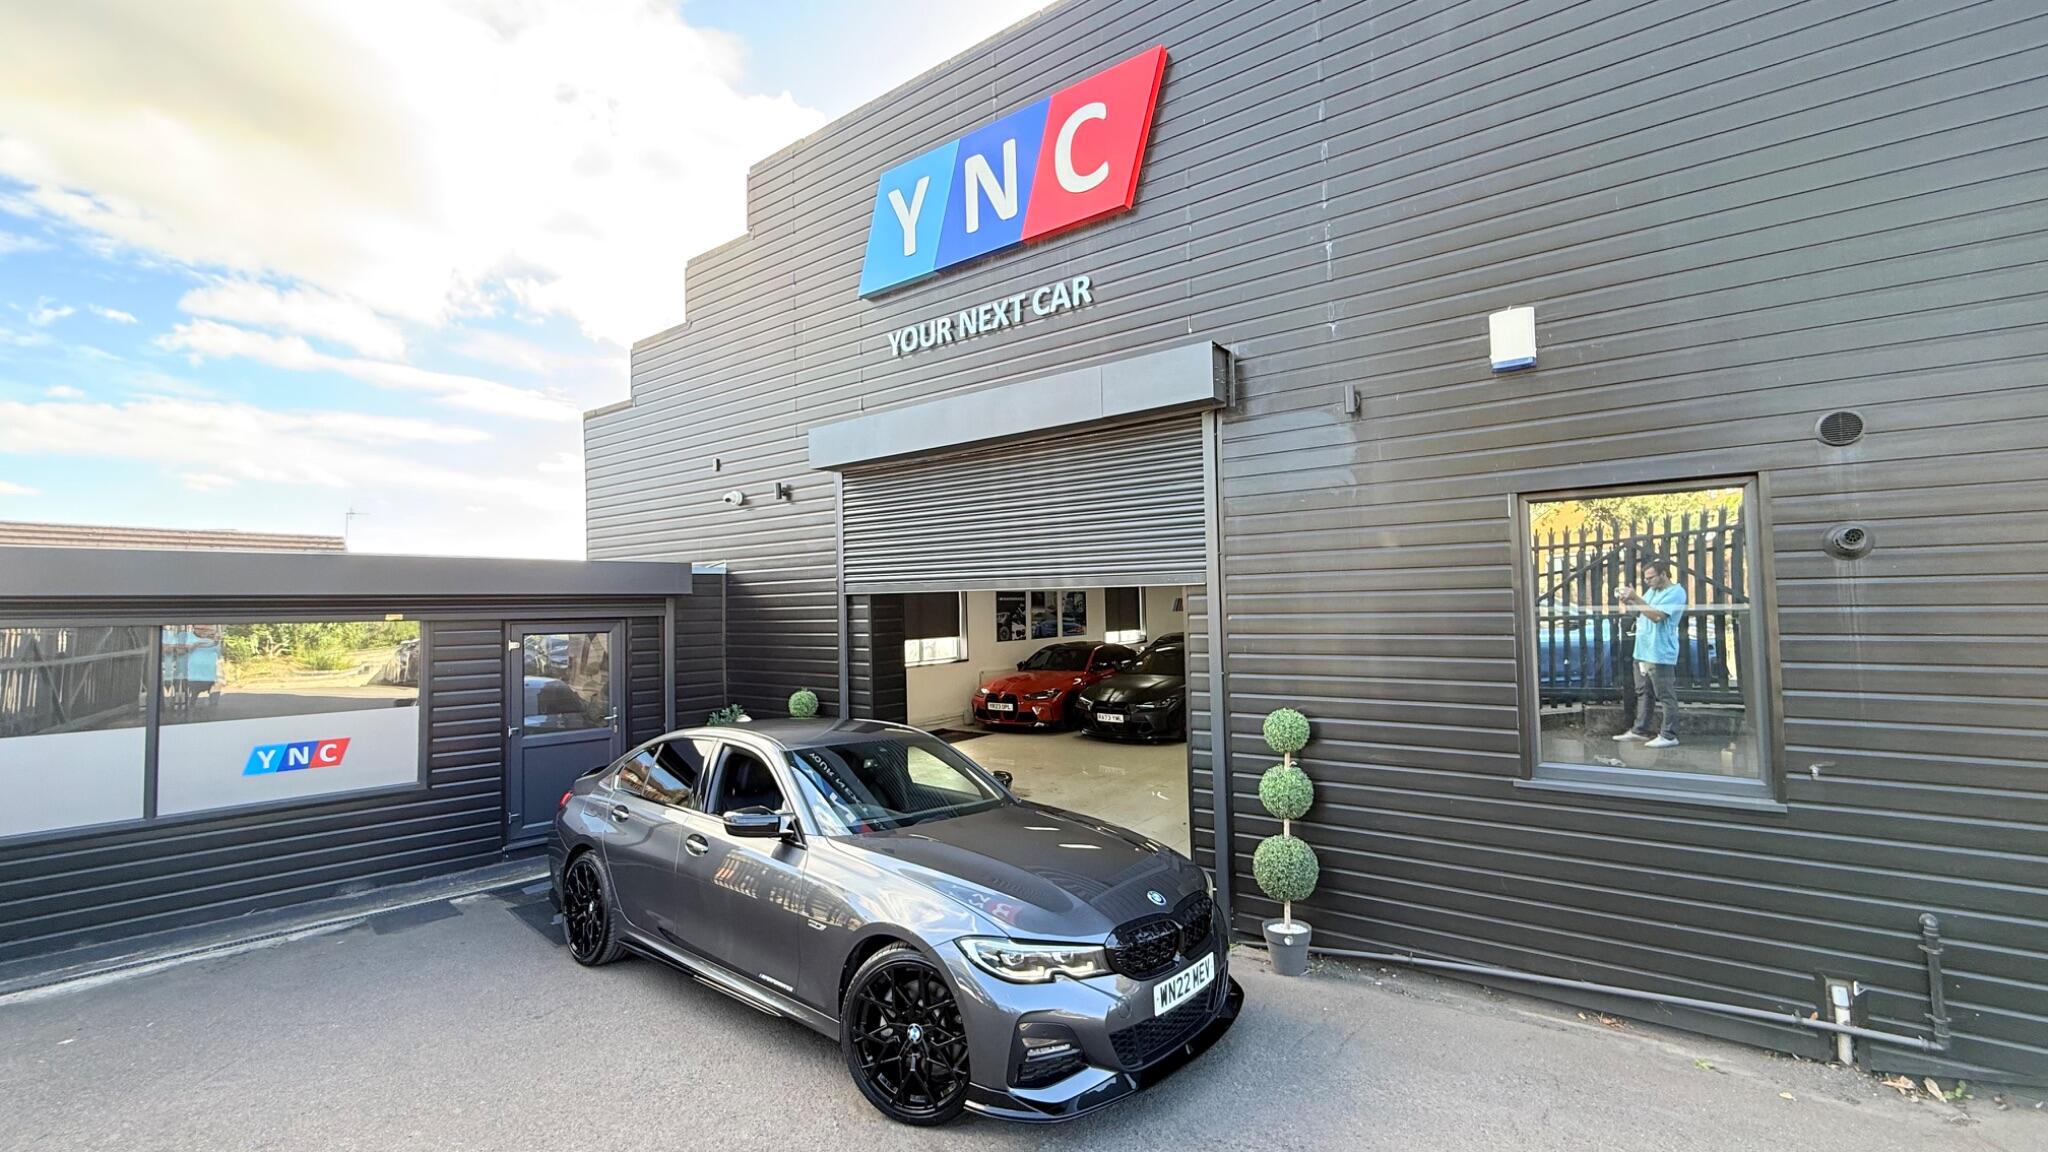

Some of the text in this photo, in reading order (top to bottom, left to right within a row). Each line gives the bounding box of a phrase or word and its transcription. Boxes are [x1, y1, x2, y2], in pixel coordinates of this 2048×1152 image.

[888, 102, 1109, 256] YNC
[888, 275, 1092, 356] YOUR NEXT CAR
[257, 744, 337, 769] YNC
[1160, 959, 1210, 1008] WN22 MEV
